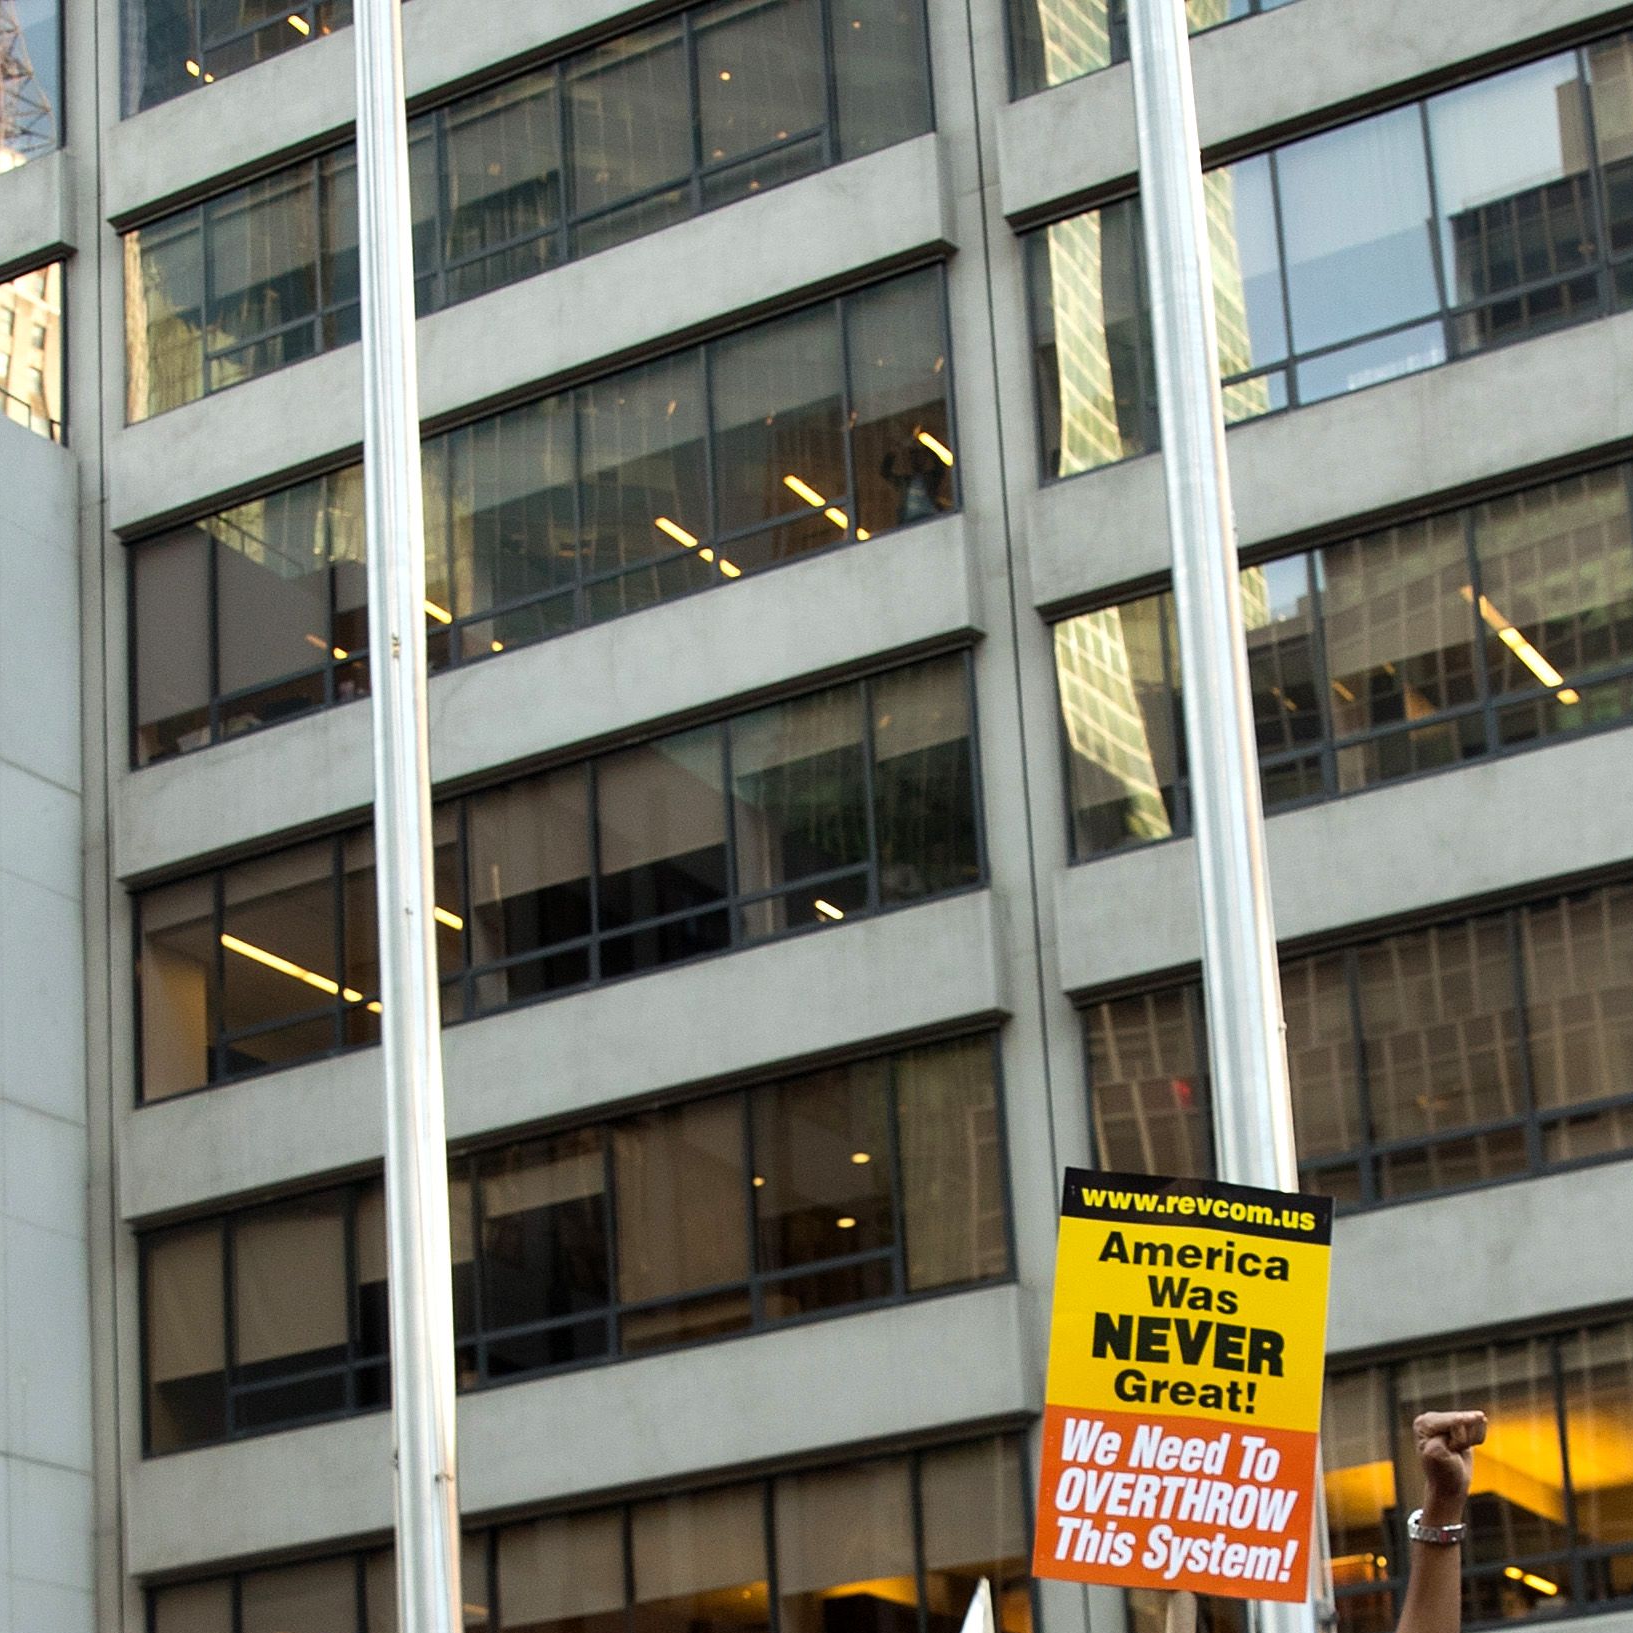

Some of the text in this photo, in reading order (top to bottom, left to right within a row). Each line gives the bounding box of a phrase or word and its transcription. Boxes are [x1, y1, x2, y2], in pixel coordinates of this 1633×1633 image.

[1081, 1187, 1316, 1231] www.revcom.us
[1098, 1231, 1289, 1281] America
[1148, 1275, 1238, 1315] Was
[1092, 1311, 1285, 1378] NEVER
[1113, 1368, 1256, 1415] Great!
[1061, 1417, 1281, 1483] We Need To
[1054, 1466, 1299, 1533] OVERTHROW
[1054, 1515, 1300, 1583] This System!
